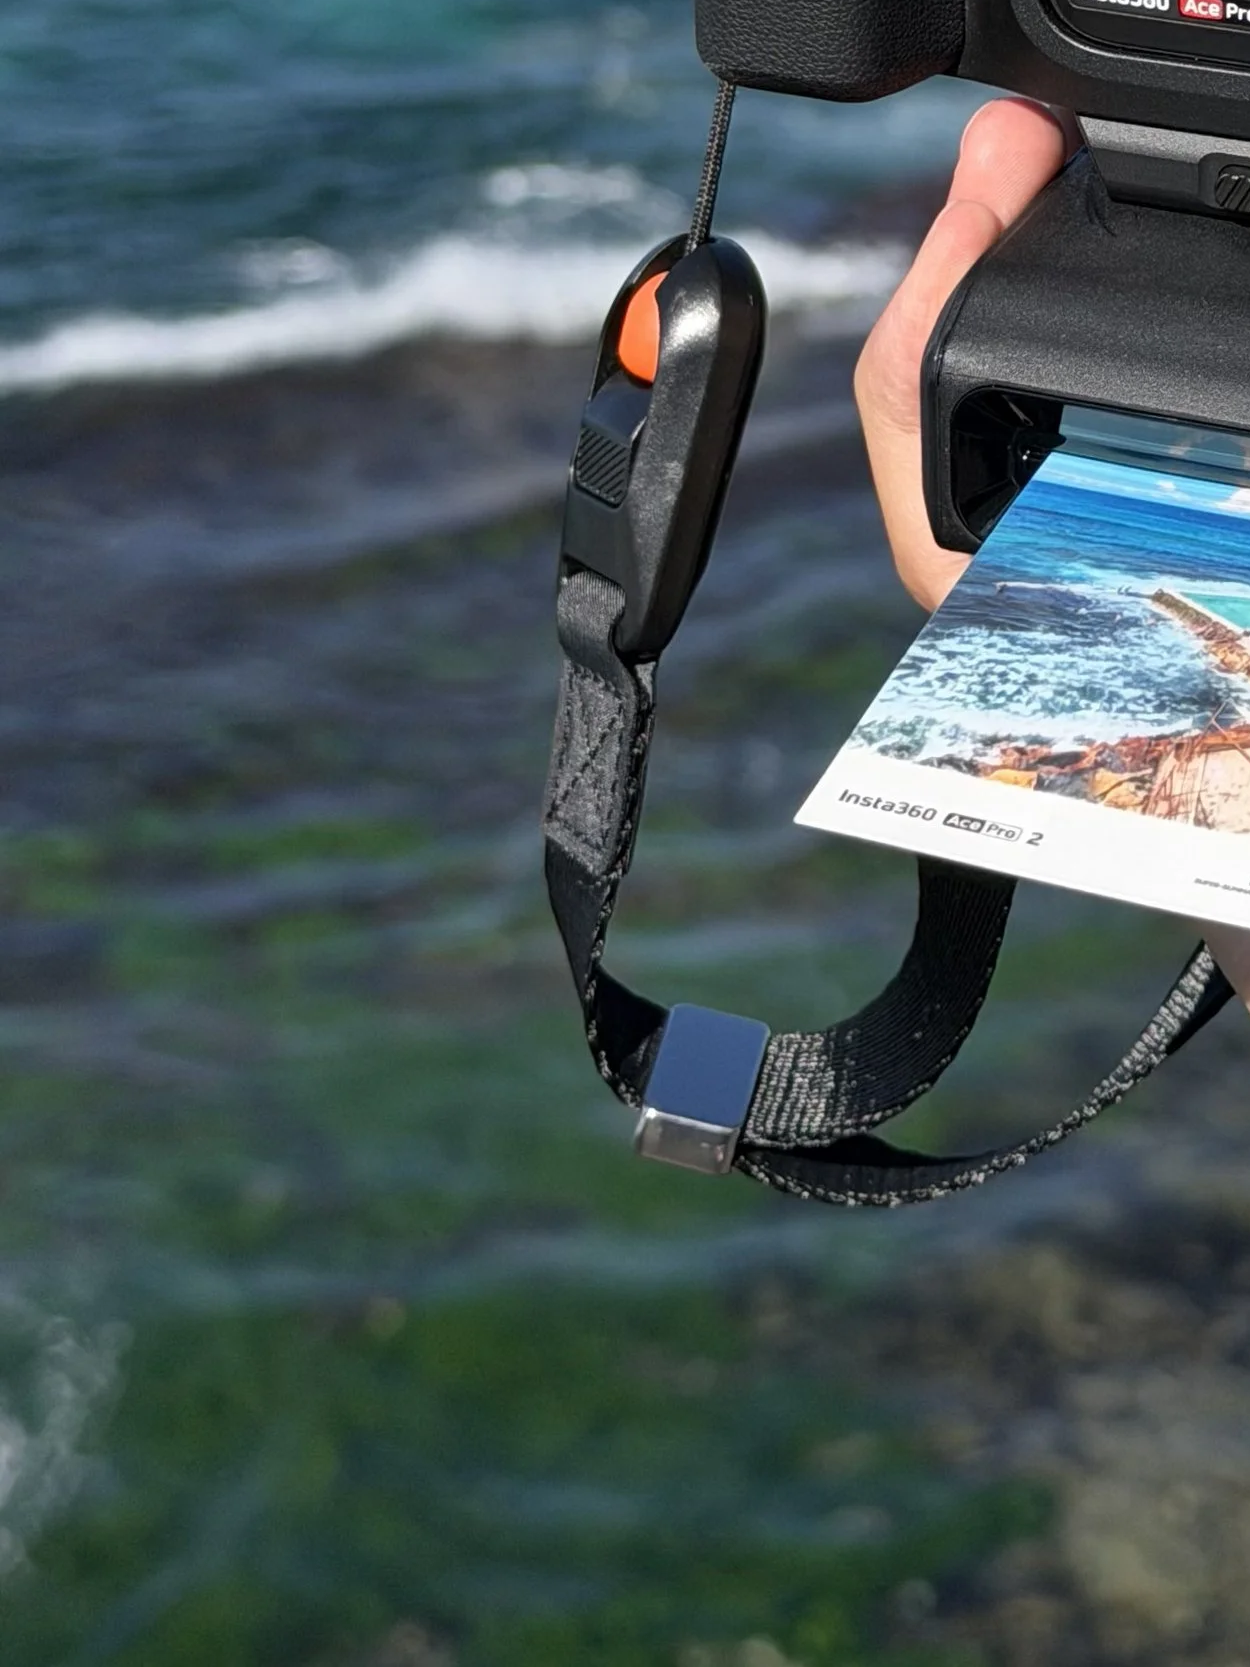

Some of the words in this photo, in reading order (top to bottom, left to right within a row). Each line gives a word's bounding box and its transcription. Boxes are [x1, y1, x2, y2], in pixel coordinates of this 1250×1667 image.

[838, 788, 938, 822] Insta360
[946, 814, 982, 831] Ace
[986, 823, 1017, 840] Pro
[1026, 831, 1044, 846] 2
